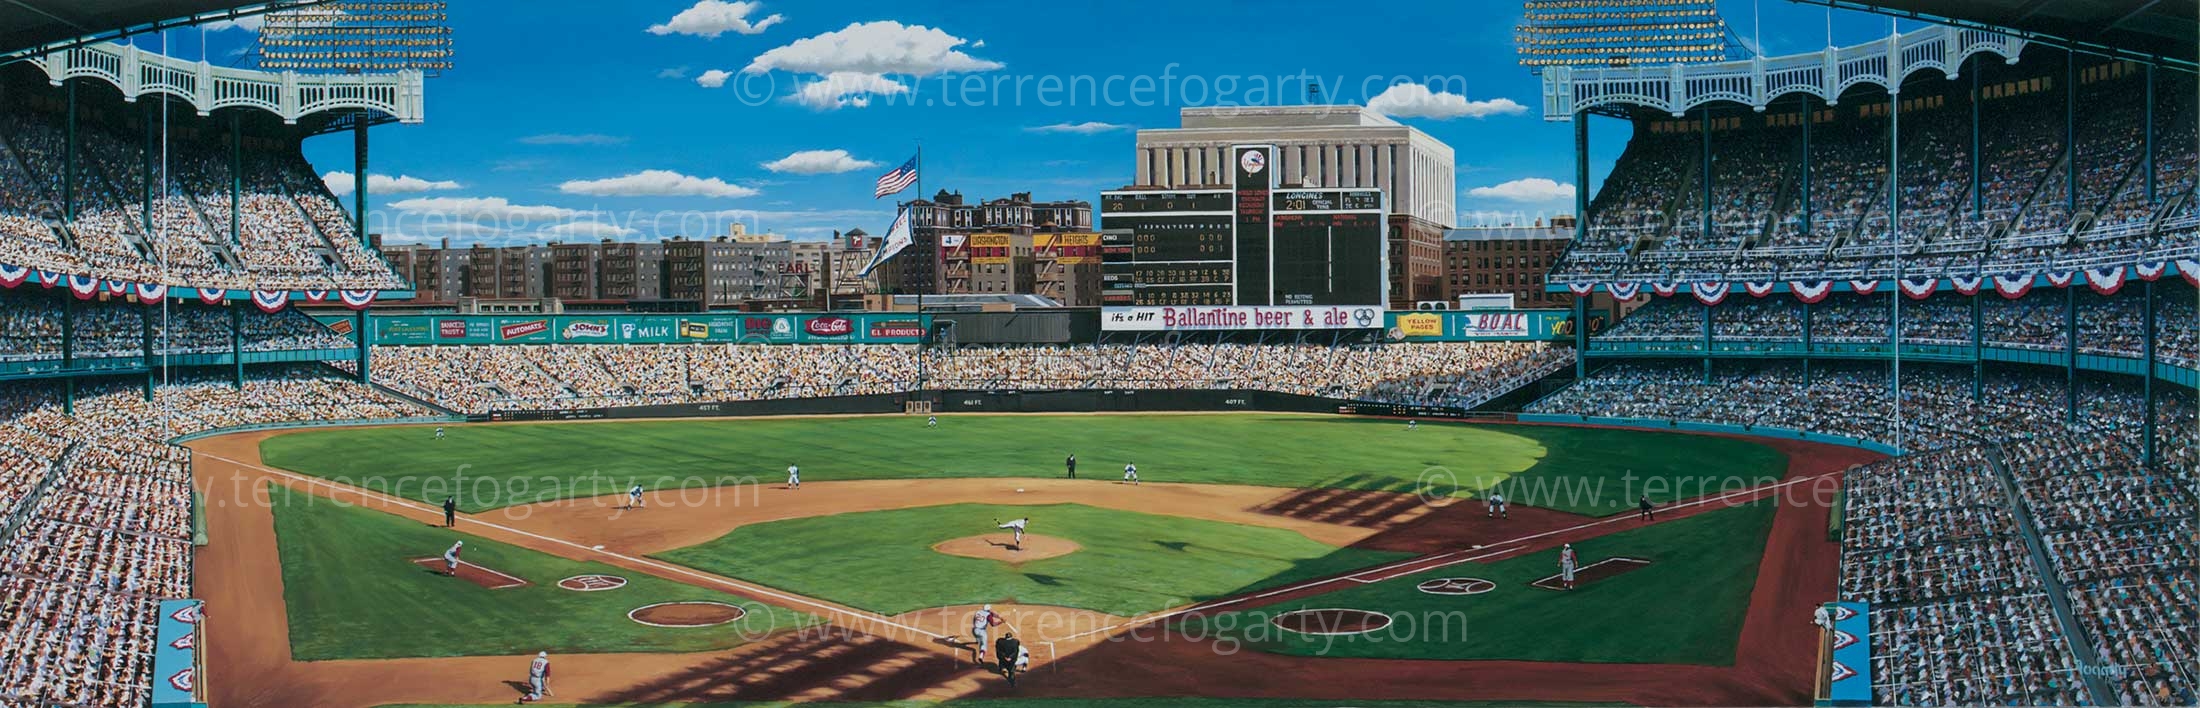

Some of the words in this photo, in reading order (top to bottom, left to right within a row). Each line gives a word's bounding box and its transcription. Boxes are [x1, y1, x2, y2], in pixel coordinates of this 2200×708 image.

[1113, 202, 1123, 210] 20
[1286, 200, 1306, 210] 2:01
[972, 236, 1008, 246] WASHINGTON
[1064, 236, 1088, 246] HEIGHTS
[1111, 313, 1124, 322] it's
[1136, 313, 1154, 322] HIT
[1163, 308, 1247, 327] Ballantine
[1255, 308, 1293, 326] beer
[1304, 310, 1314, 326] &
[1324, 308, 1348, 326] ale
[639, 326, 669, 338] MILK
[534, 661, 542, 669] 18
